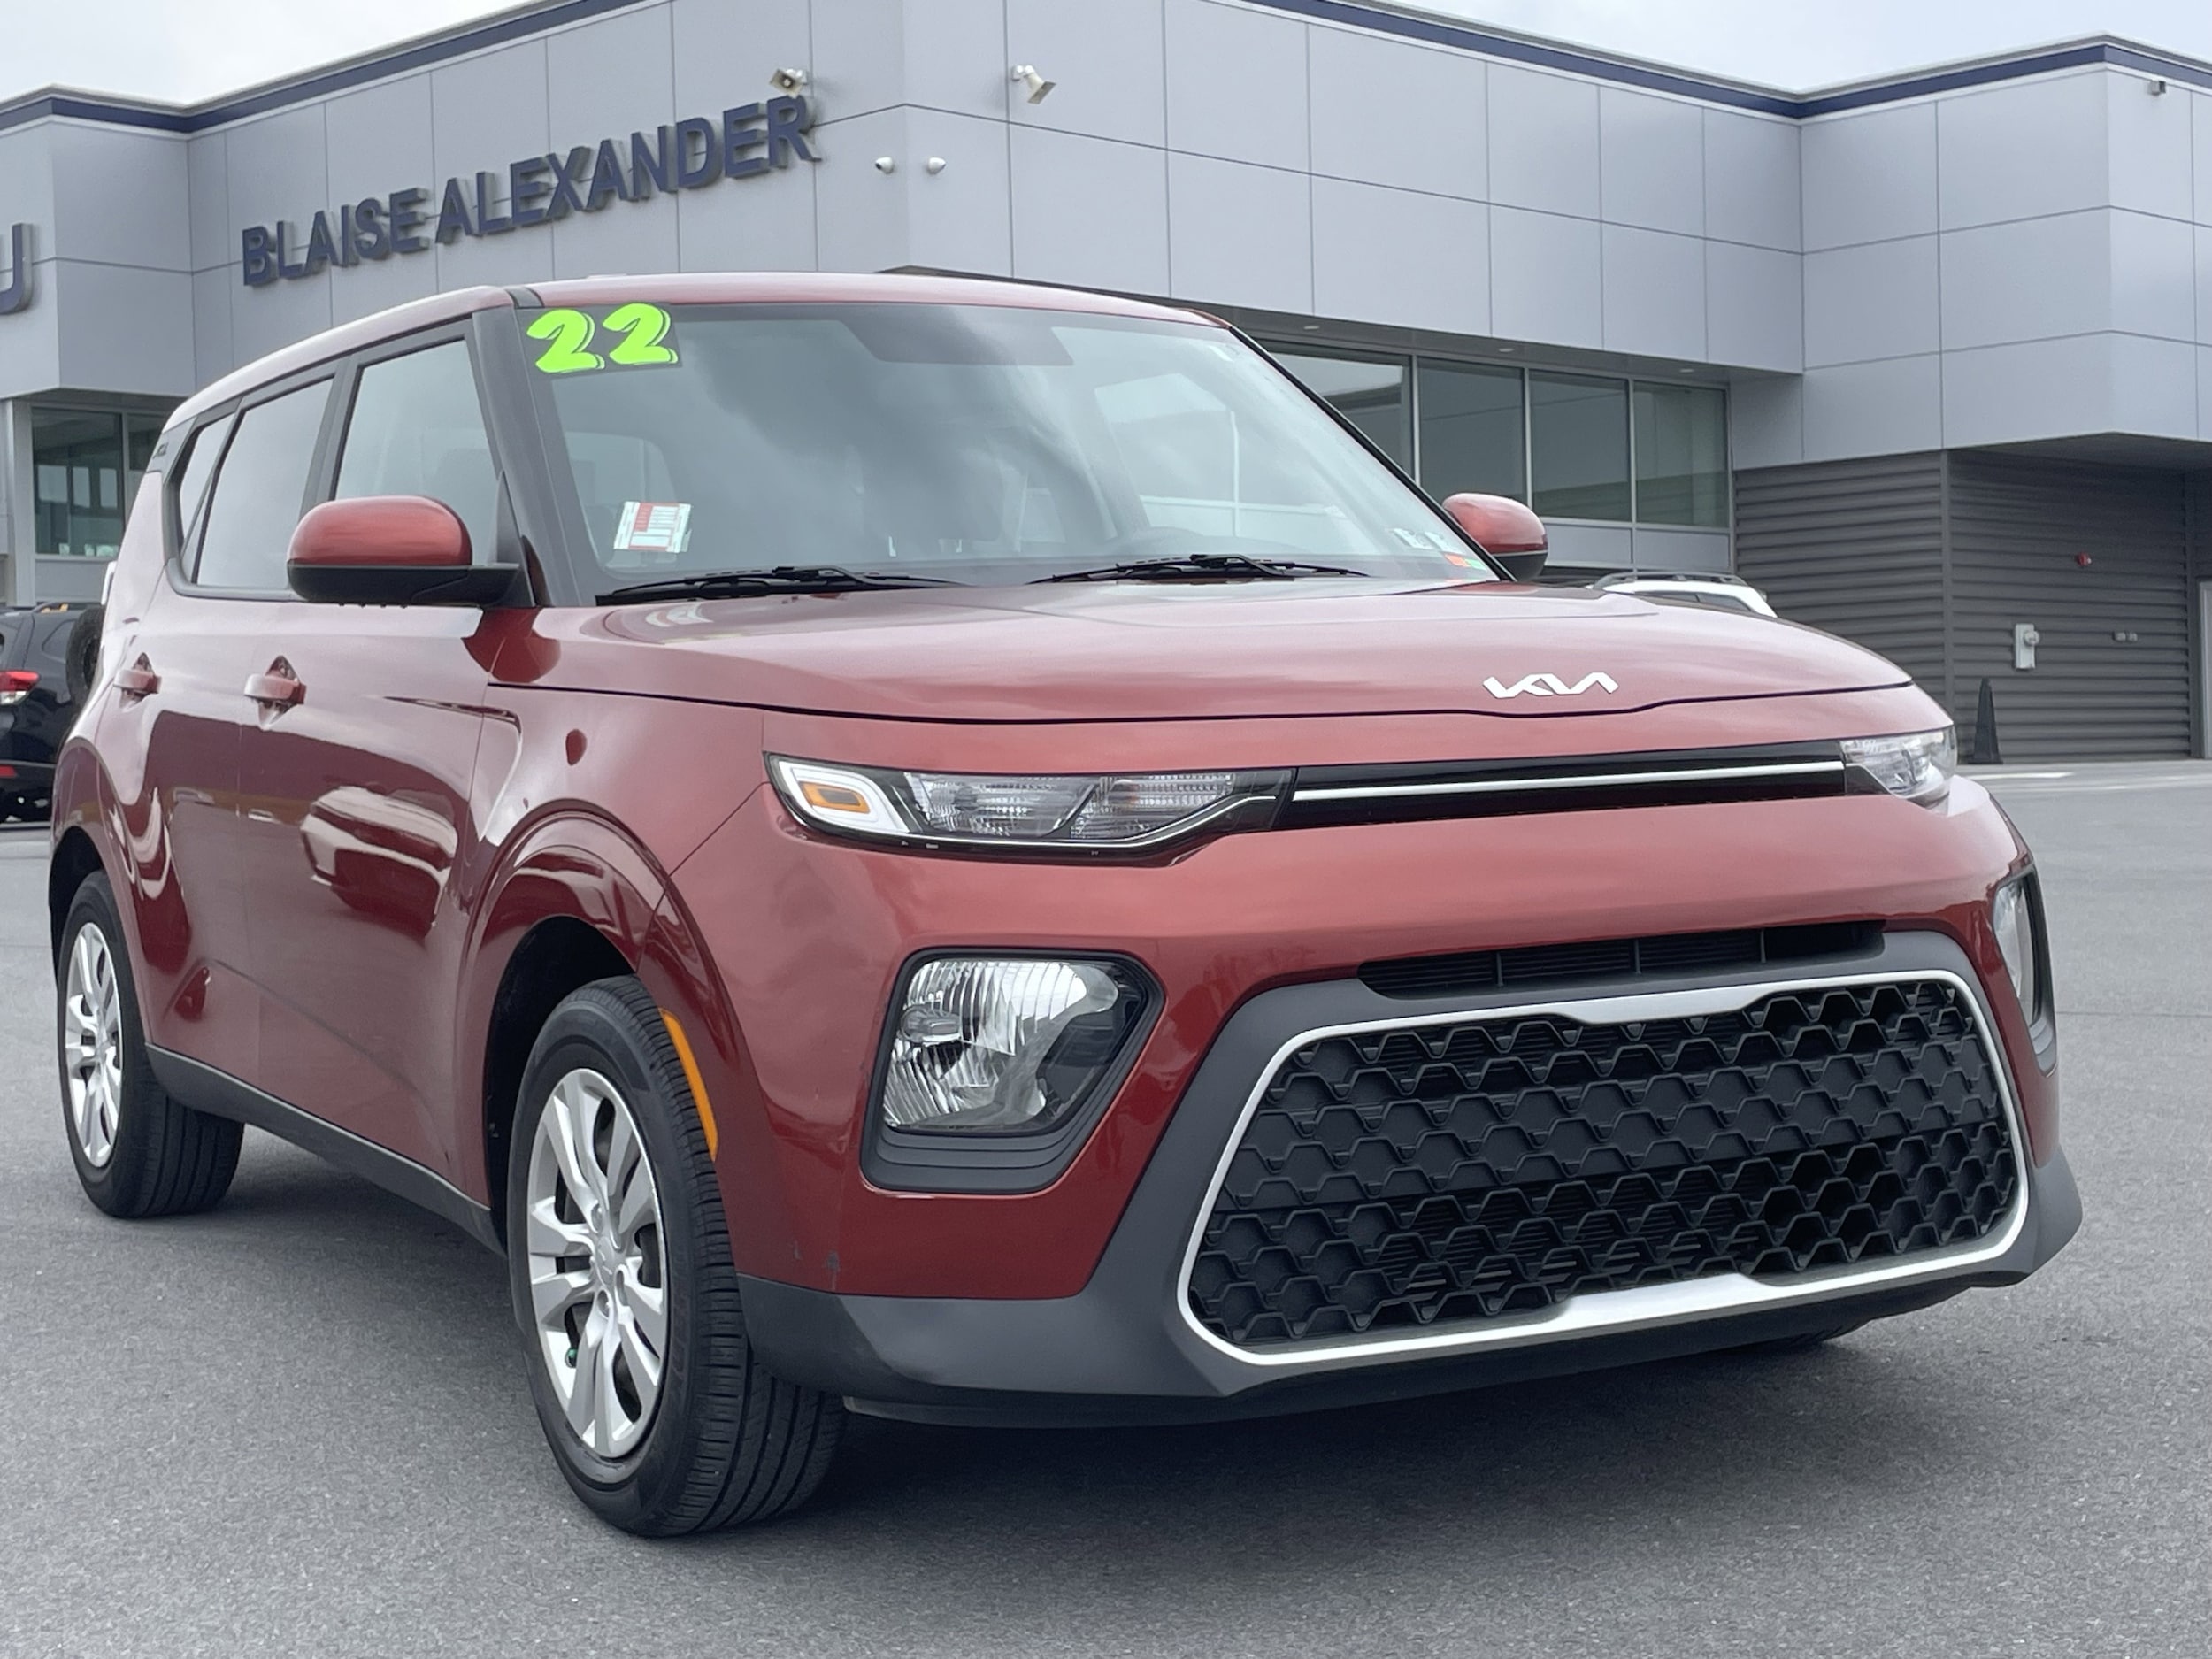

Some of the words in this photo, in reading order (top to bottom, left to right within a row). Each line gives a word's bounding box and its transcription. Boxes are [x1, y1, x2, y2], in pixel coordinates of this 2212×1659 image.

[242, 188, 431, 287] BLAISE
[435, 95, 821, 244] ALEXANDER
[526, 302, 679, 373] 22
